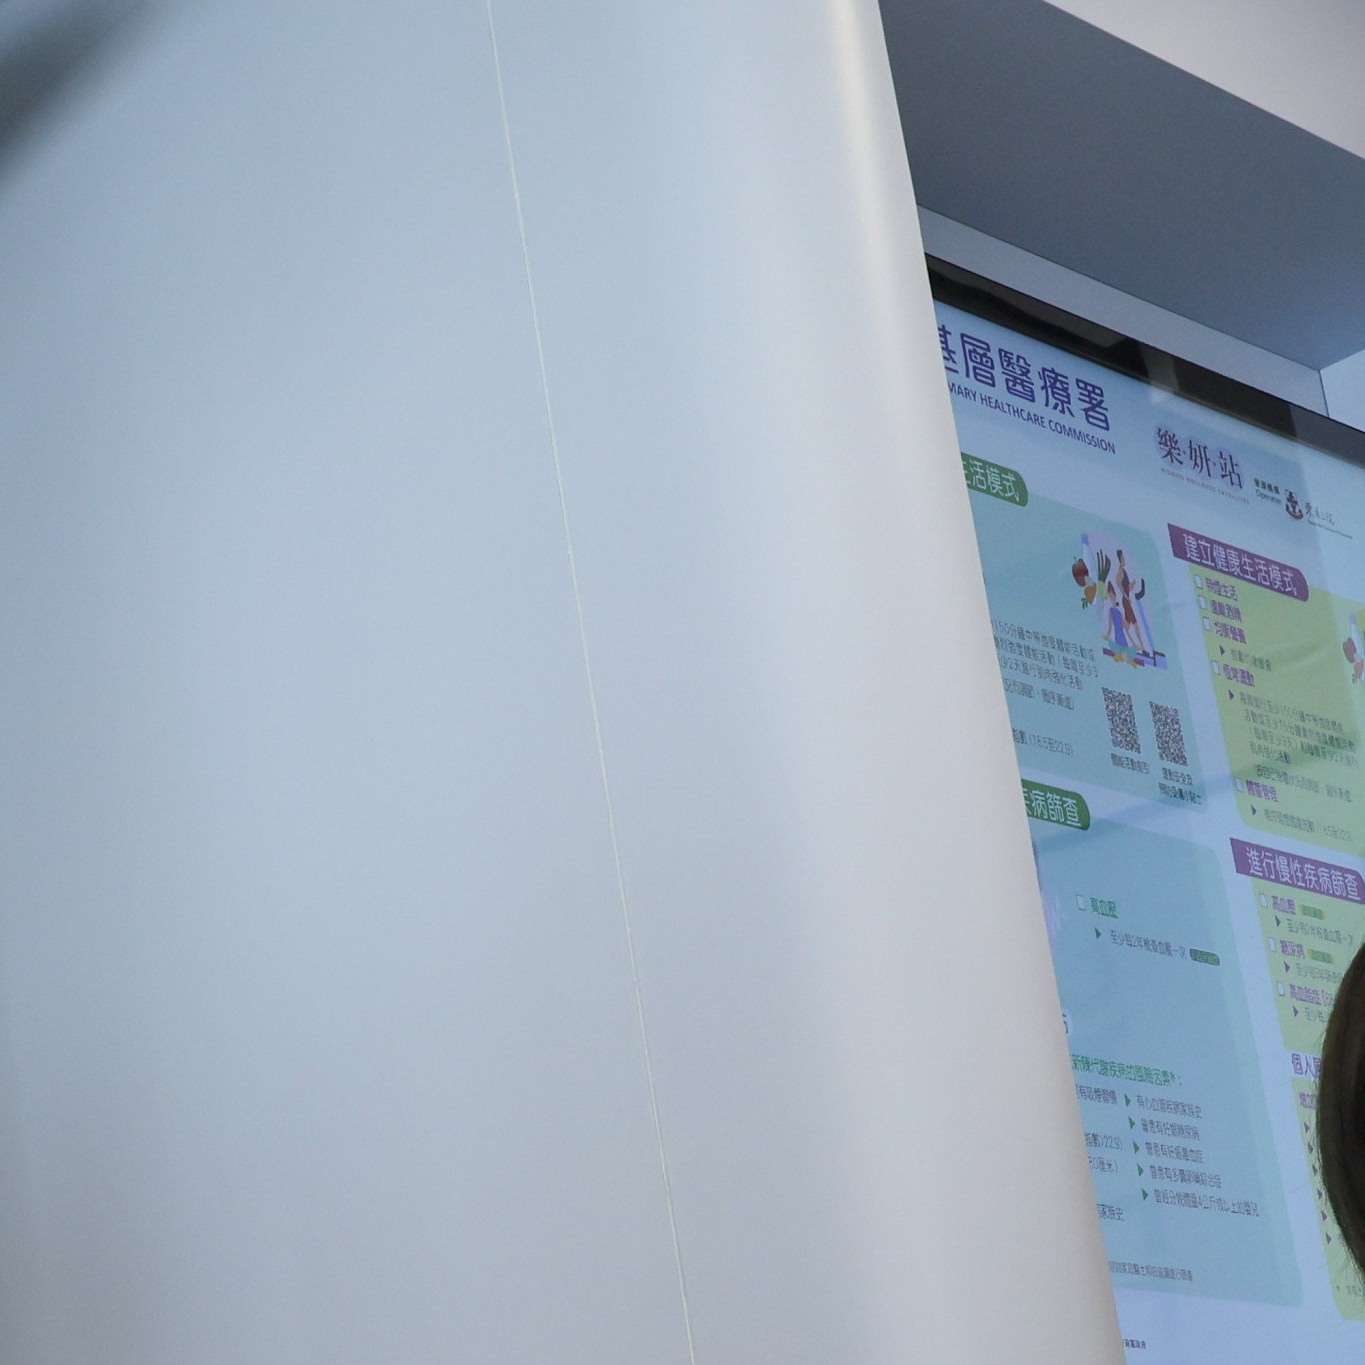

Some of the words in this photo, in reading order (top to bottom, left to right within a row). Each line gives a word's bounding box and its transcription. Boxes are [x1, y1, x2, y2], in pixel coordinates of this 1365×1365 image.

[980, 393, 1046, 428] HEALTHCARE
[1048, 419, 1116, 454] COMMISSION
[1183, 533, 1298, 596] 建立健康生活模式
[1246, 847, 1361, 900] 進行慢性疾病篩查
